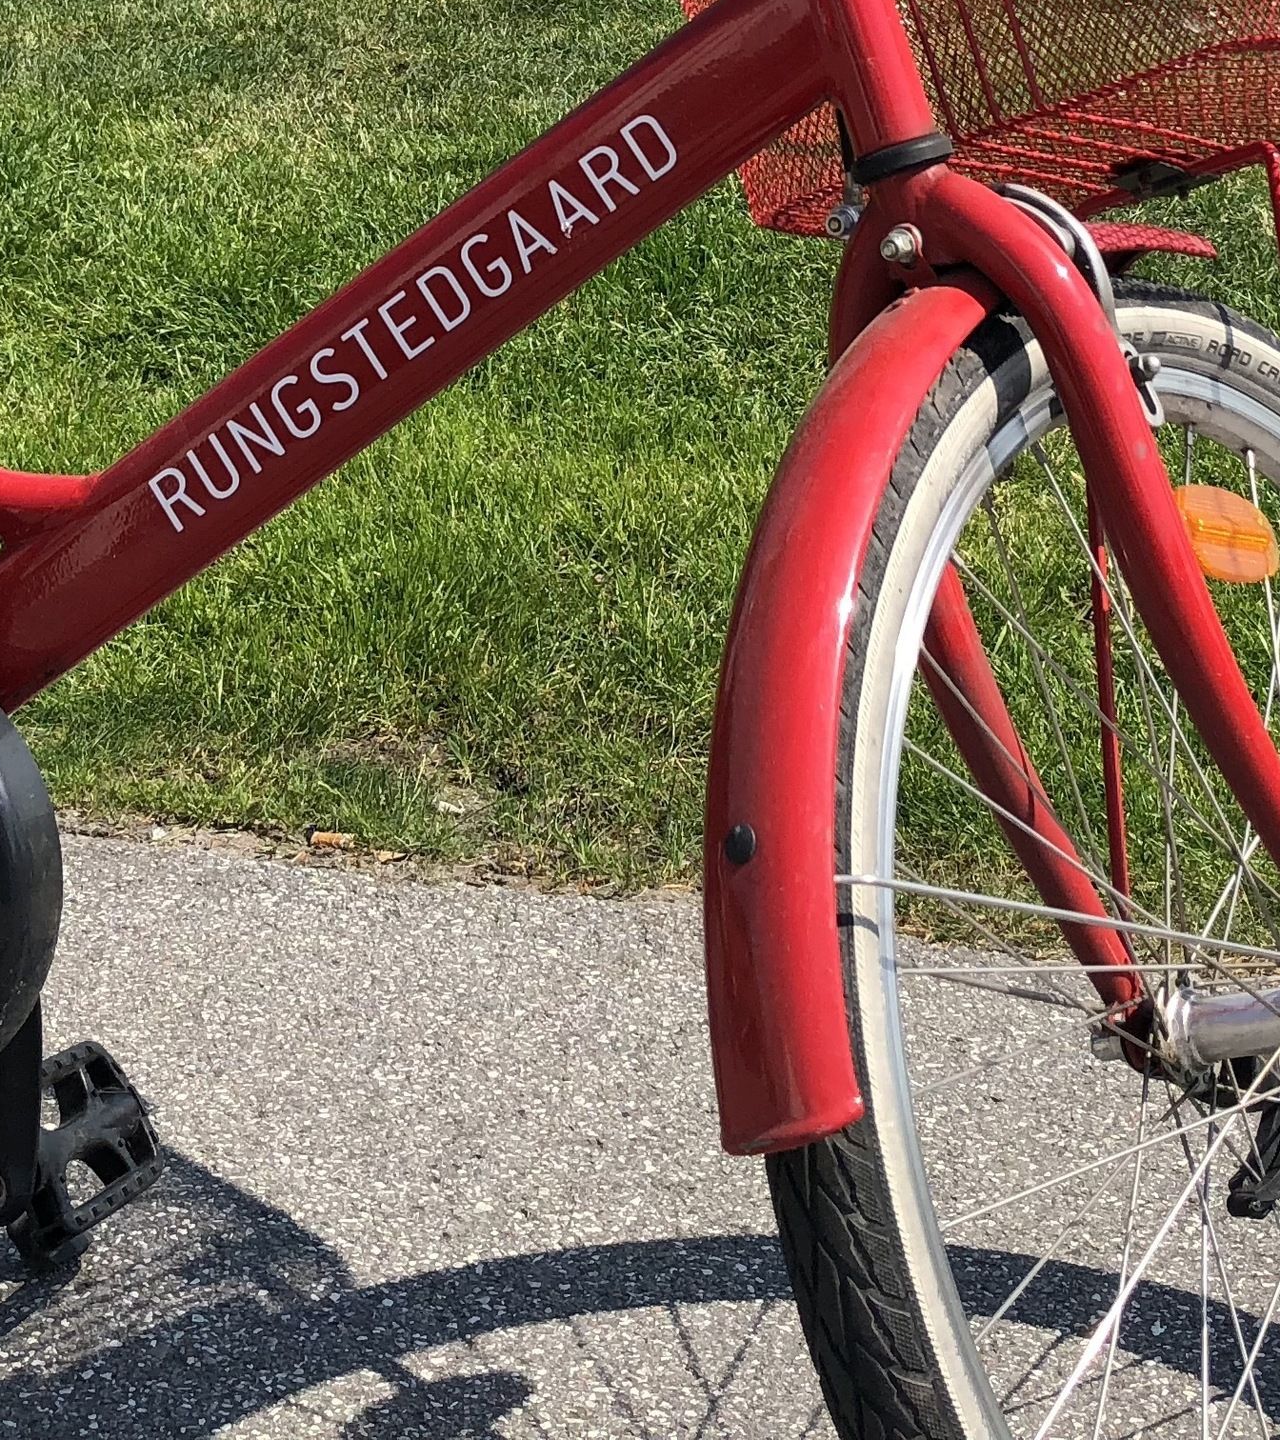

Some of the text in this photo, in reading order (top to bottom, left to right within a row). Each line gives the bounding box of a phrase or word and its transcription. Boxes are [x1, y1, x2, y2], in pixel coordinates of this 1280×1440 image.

[148, 113, 678, 532] RUNGSTEDGAARD
[1166, 334, 1200, 349] ACTIVE
[1206, 339, 1252, 366] ROAD
